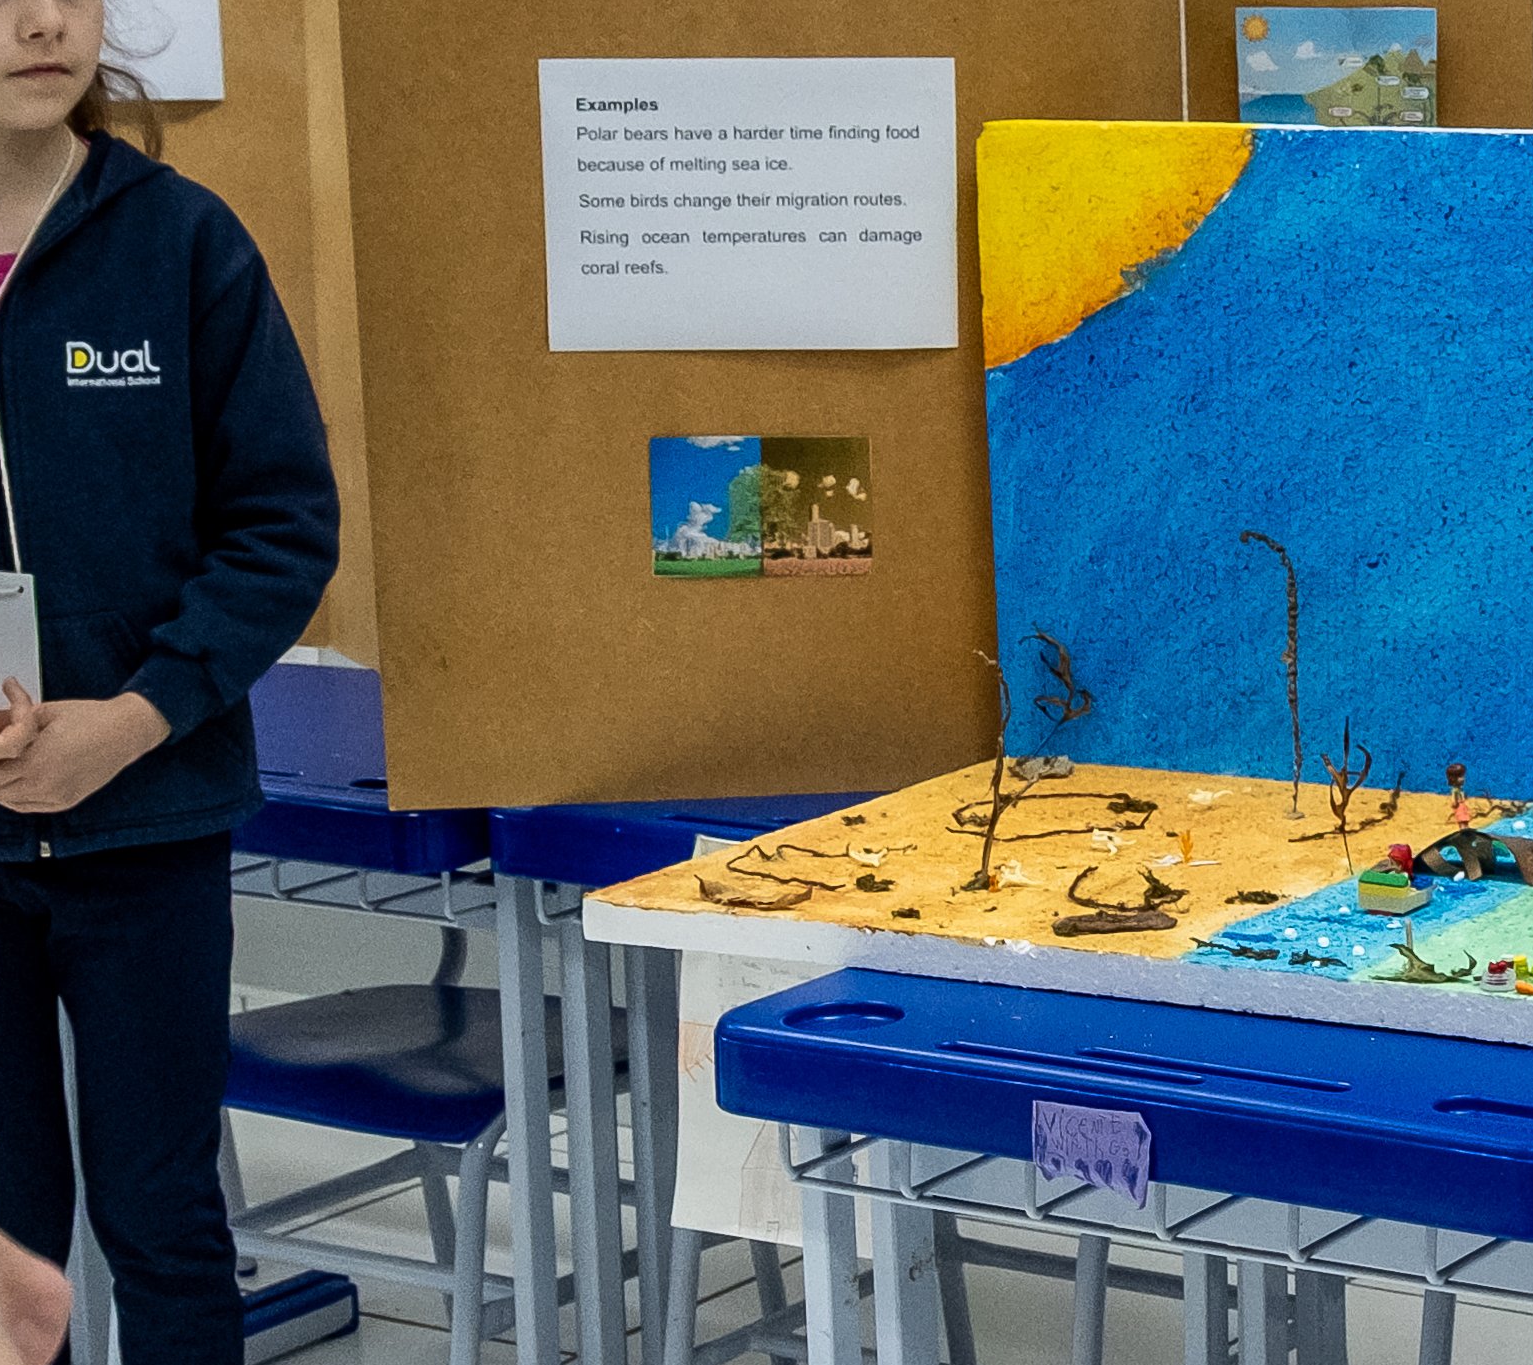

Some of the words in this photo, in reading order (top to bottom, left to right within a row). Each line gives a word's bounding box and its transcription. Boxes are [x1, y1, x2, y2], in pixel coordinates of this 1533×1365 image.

[576, 97, 659, 114] Examples
[577, 126, 619, 141] Polar
[624, 127, 669, 141] bears
[674, 126, 713, 141] have
[718, 129, 728, 141] a
[733, 126, 785, 140] harder
[790, 127, 823, 140] time
[829, 125, 881, 142] finding
[886, 125, 920, 140] food
[577, 158, 645, 173] because
[650, 157, 666, 172] of
[670, 157, 727, 175] melting
[732, 160, 761, 171] sea
[765, 160, 793, 171] ice.
[579, 193, 626, 209] Some
[630, 194, 669, 208] birds
[673, 193, 732, 211] change
[737, 193, 771, 207] their
[776, 193, 849, 211] migration
[854, 193, 906, 207] routes.
[580, 230, 629, 248] Rising
[642, 232, 690, 244] ocean
[703, 230, 807, 247] temperatures
[819, 232, 847, 243] can
[859, 228, 923, 245] damage
[581, 261, 620, 276] coral
[625, 260, 668, 275] reefs.
[66, 340, 161, 373] Dual
